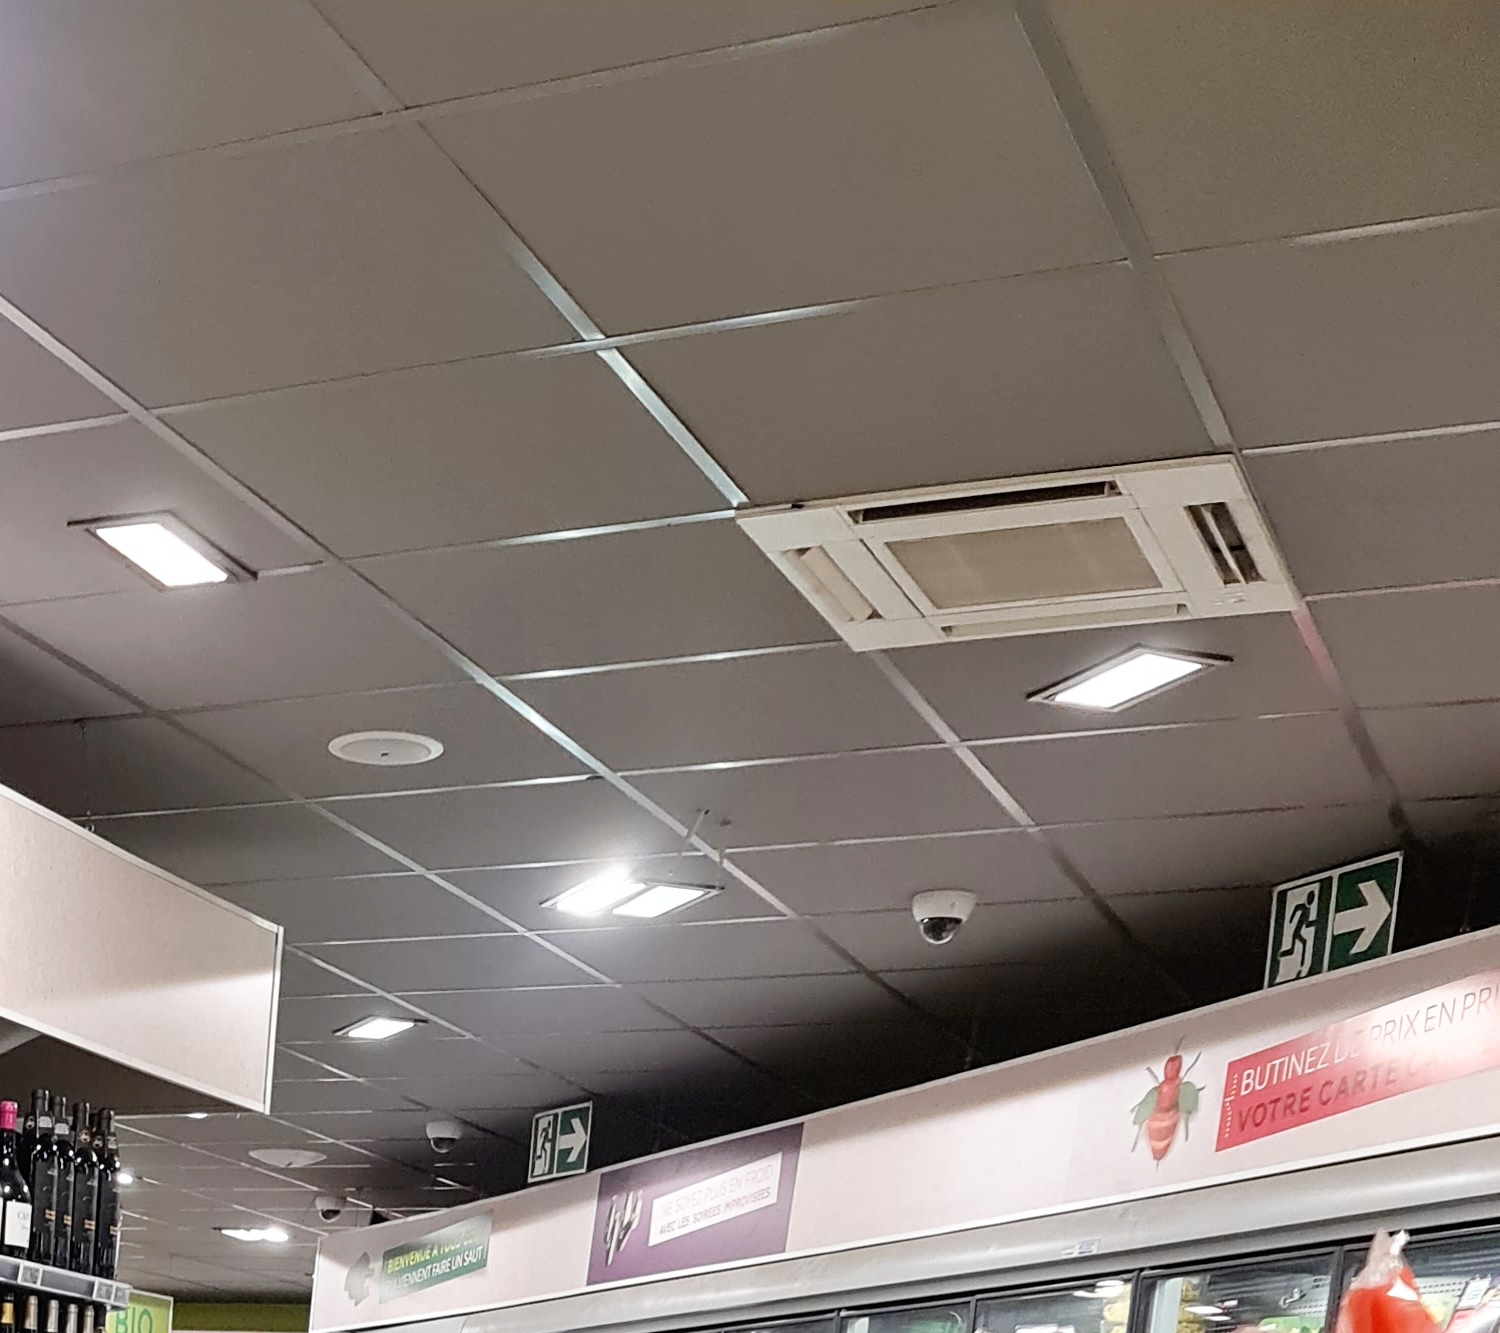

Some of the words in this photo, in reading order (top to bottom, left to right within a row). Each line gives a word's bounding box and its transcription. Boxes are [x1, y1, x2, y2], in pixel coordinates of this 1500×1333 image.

[1240, 1042, 1331, 1097] BUTINEZ
[1370, 1009, 1420, 1049] PRIX
[1423, 1001, 1456, 1033] EN
[1237, 1087, 1311, 1132] VOTRE
[1319, 1063, 1397, 1106] CARTE
[704, 1179, 728, 1202] PLUS
[730, 1175, 742, 1193] EN
[746, 1164, 773, 1186] FROID
[660, 1220, 676, 1235] AVEC
[678, 1216, 690, 1230] LES
[387, 1249, 431, 1274] BIENVENUE
[431, 1260, 452, 1277] FAIRE
[451, 1255, 464, 1270] UN
[464, 1246, 483, 1266] SAUT
